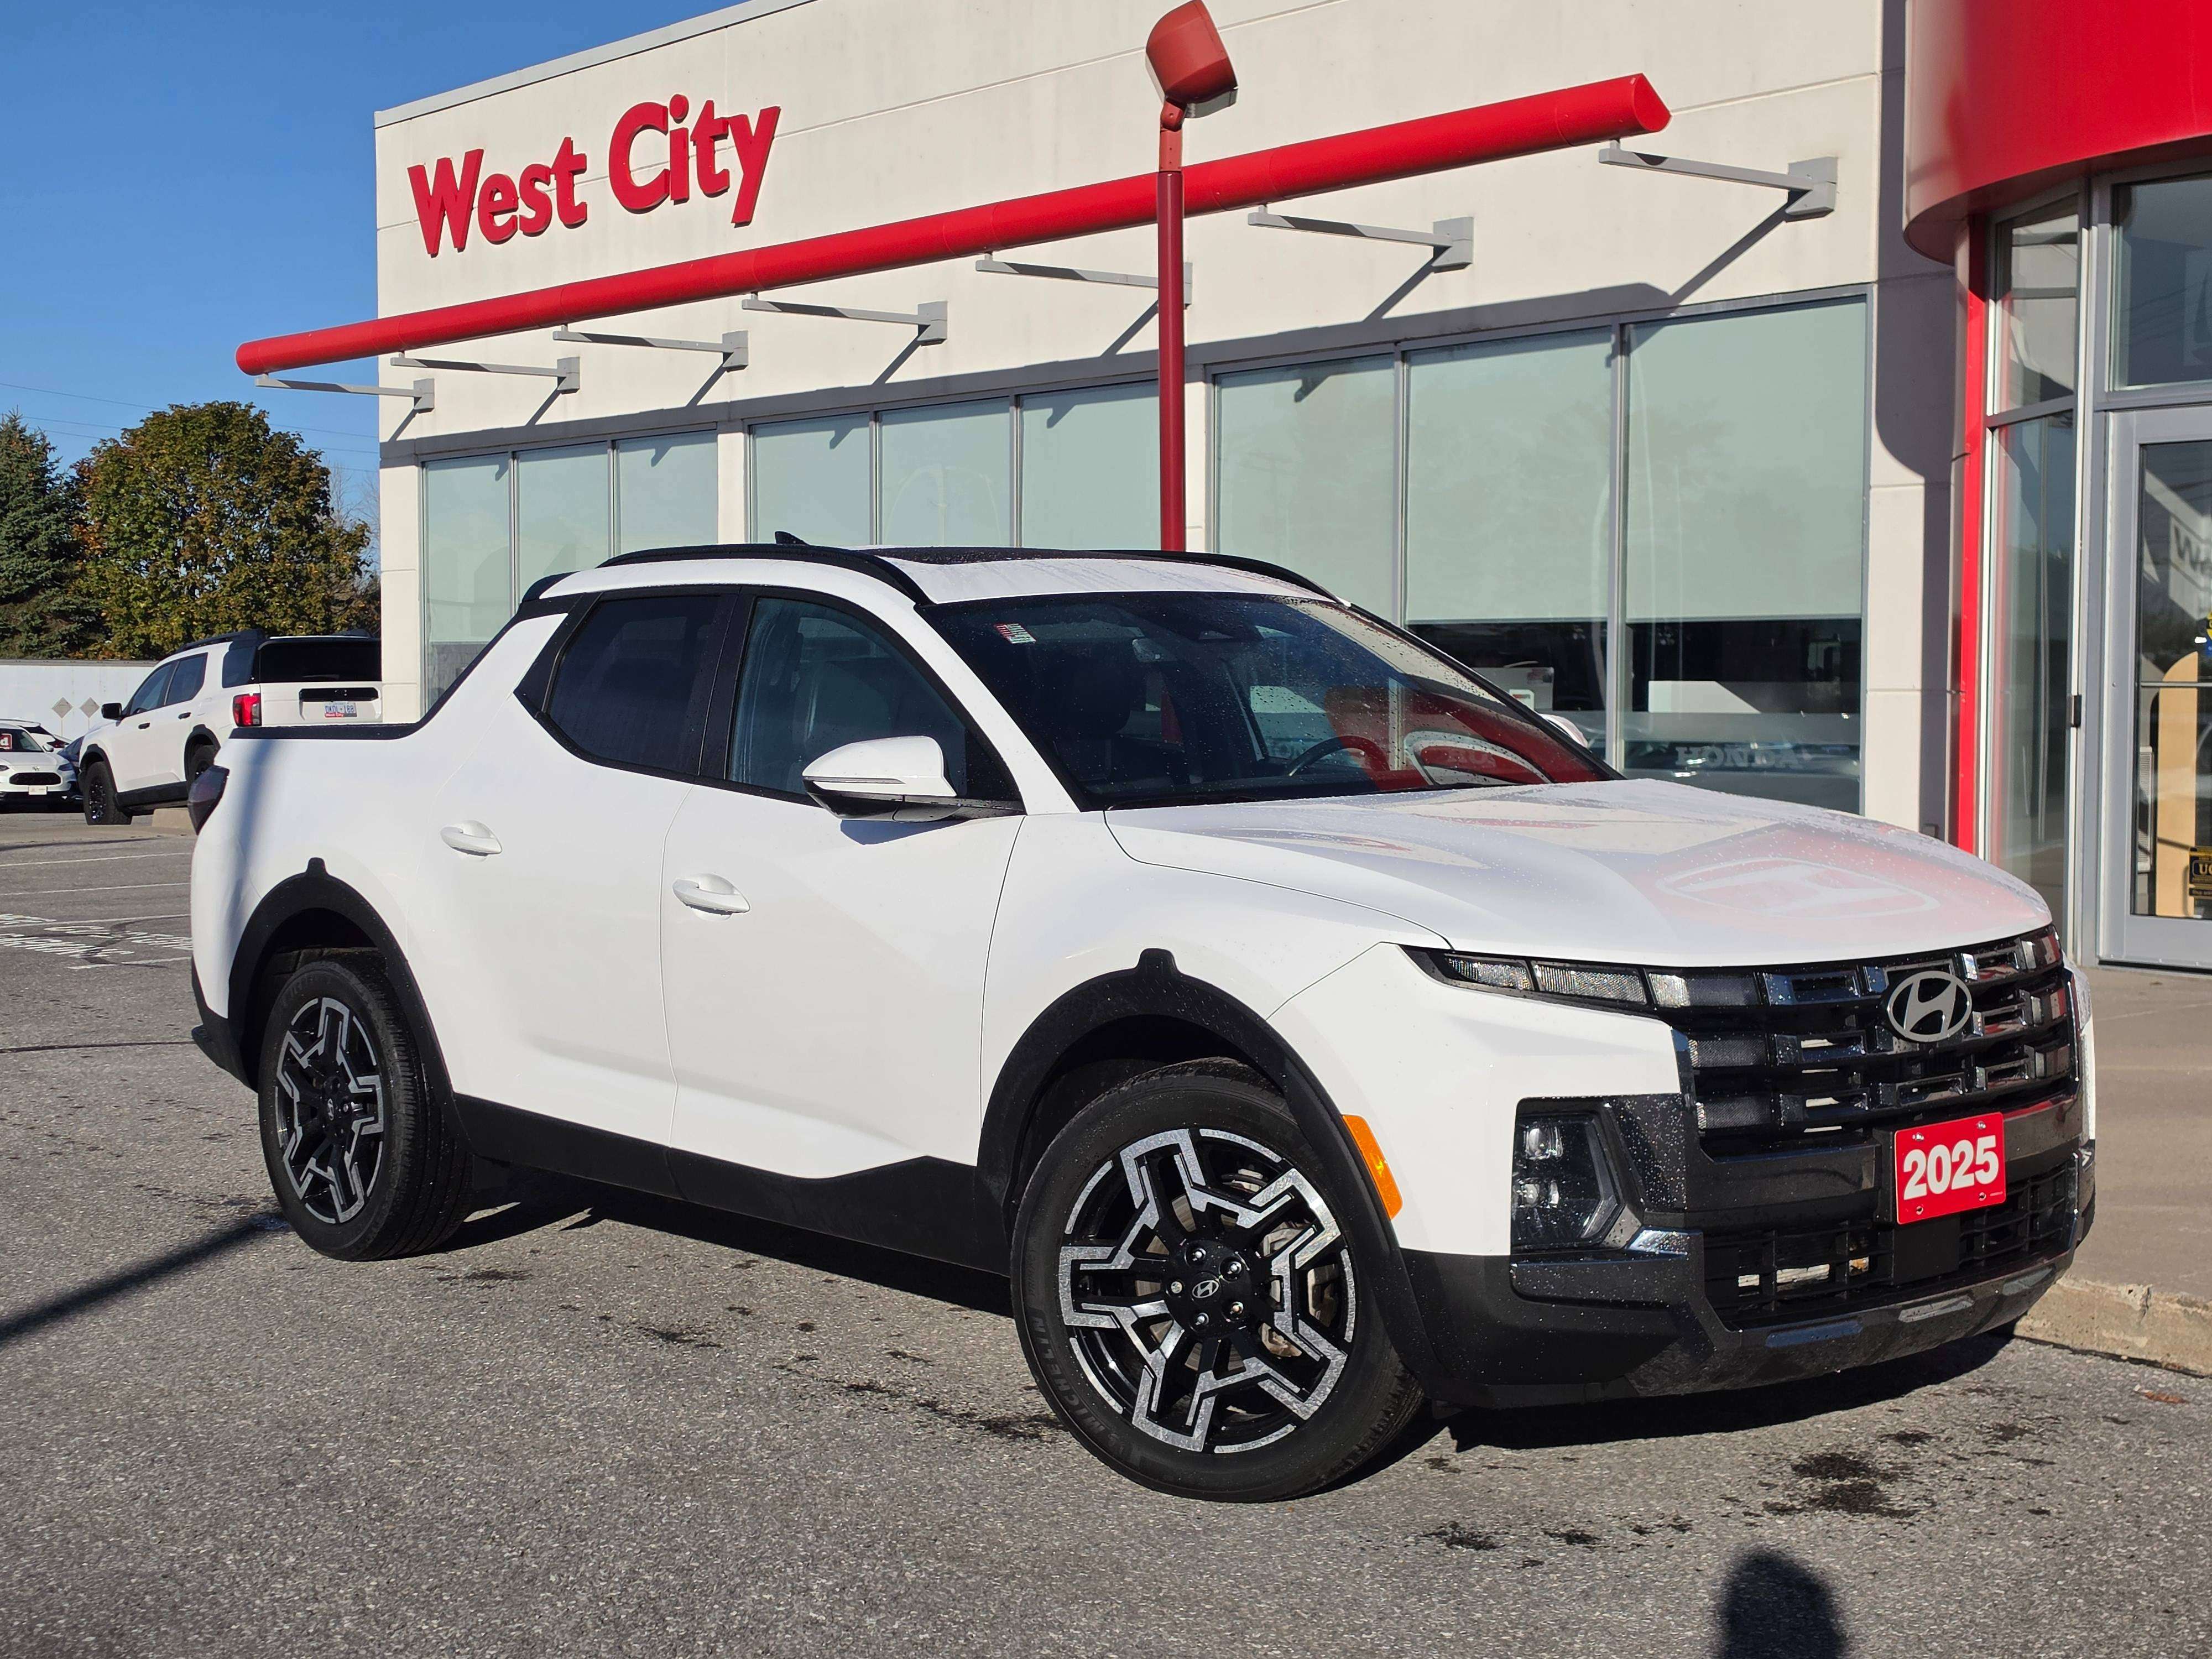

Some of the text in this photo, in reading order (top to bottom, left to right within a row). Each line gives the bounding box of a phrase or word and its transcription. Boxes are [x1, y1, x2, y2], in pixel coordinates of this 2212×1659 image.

[407, 94, 781, 258] West City
[1675, 745, 1803, 769] HONDA
[1903, 1135, 1999, 1200] 2025
[1031, 1316, 1107, 1433] MICHELIN
